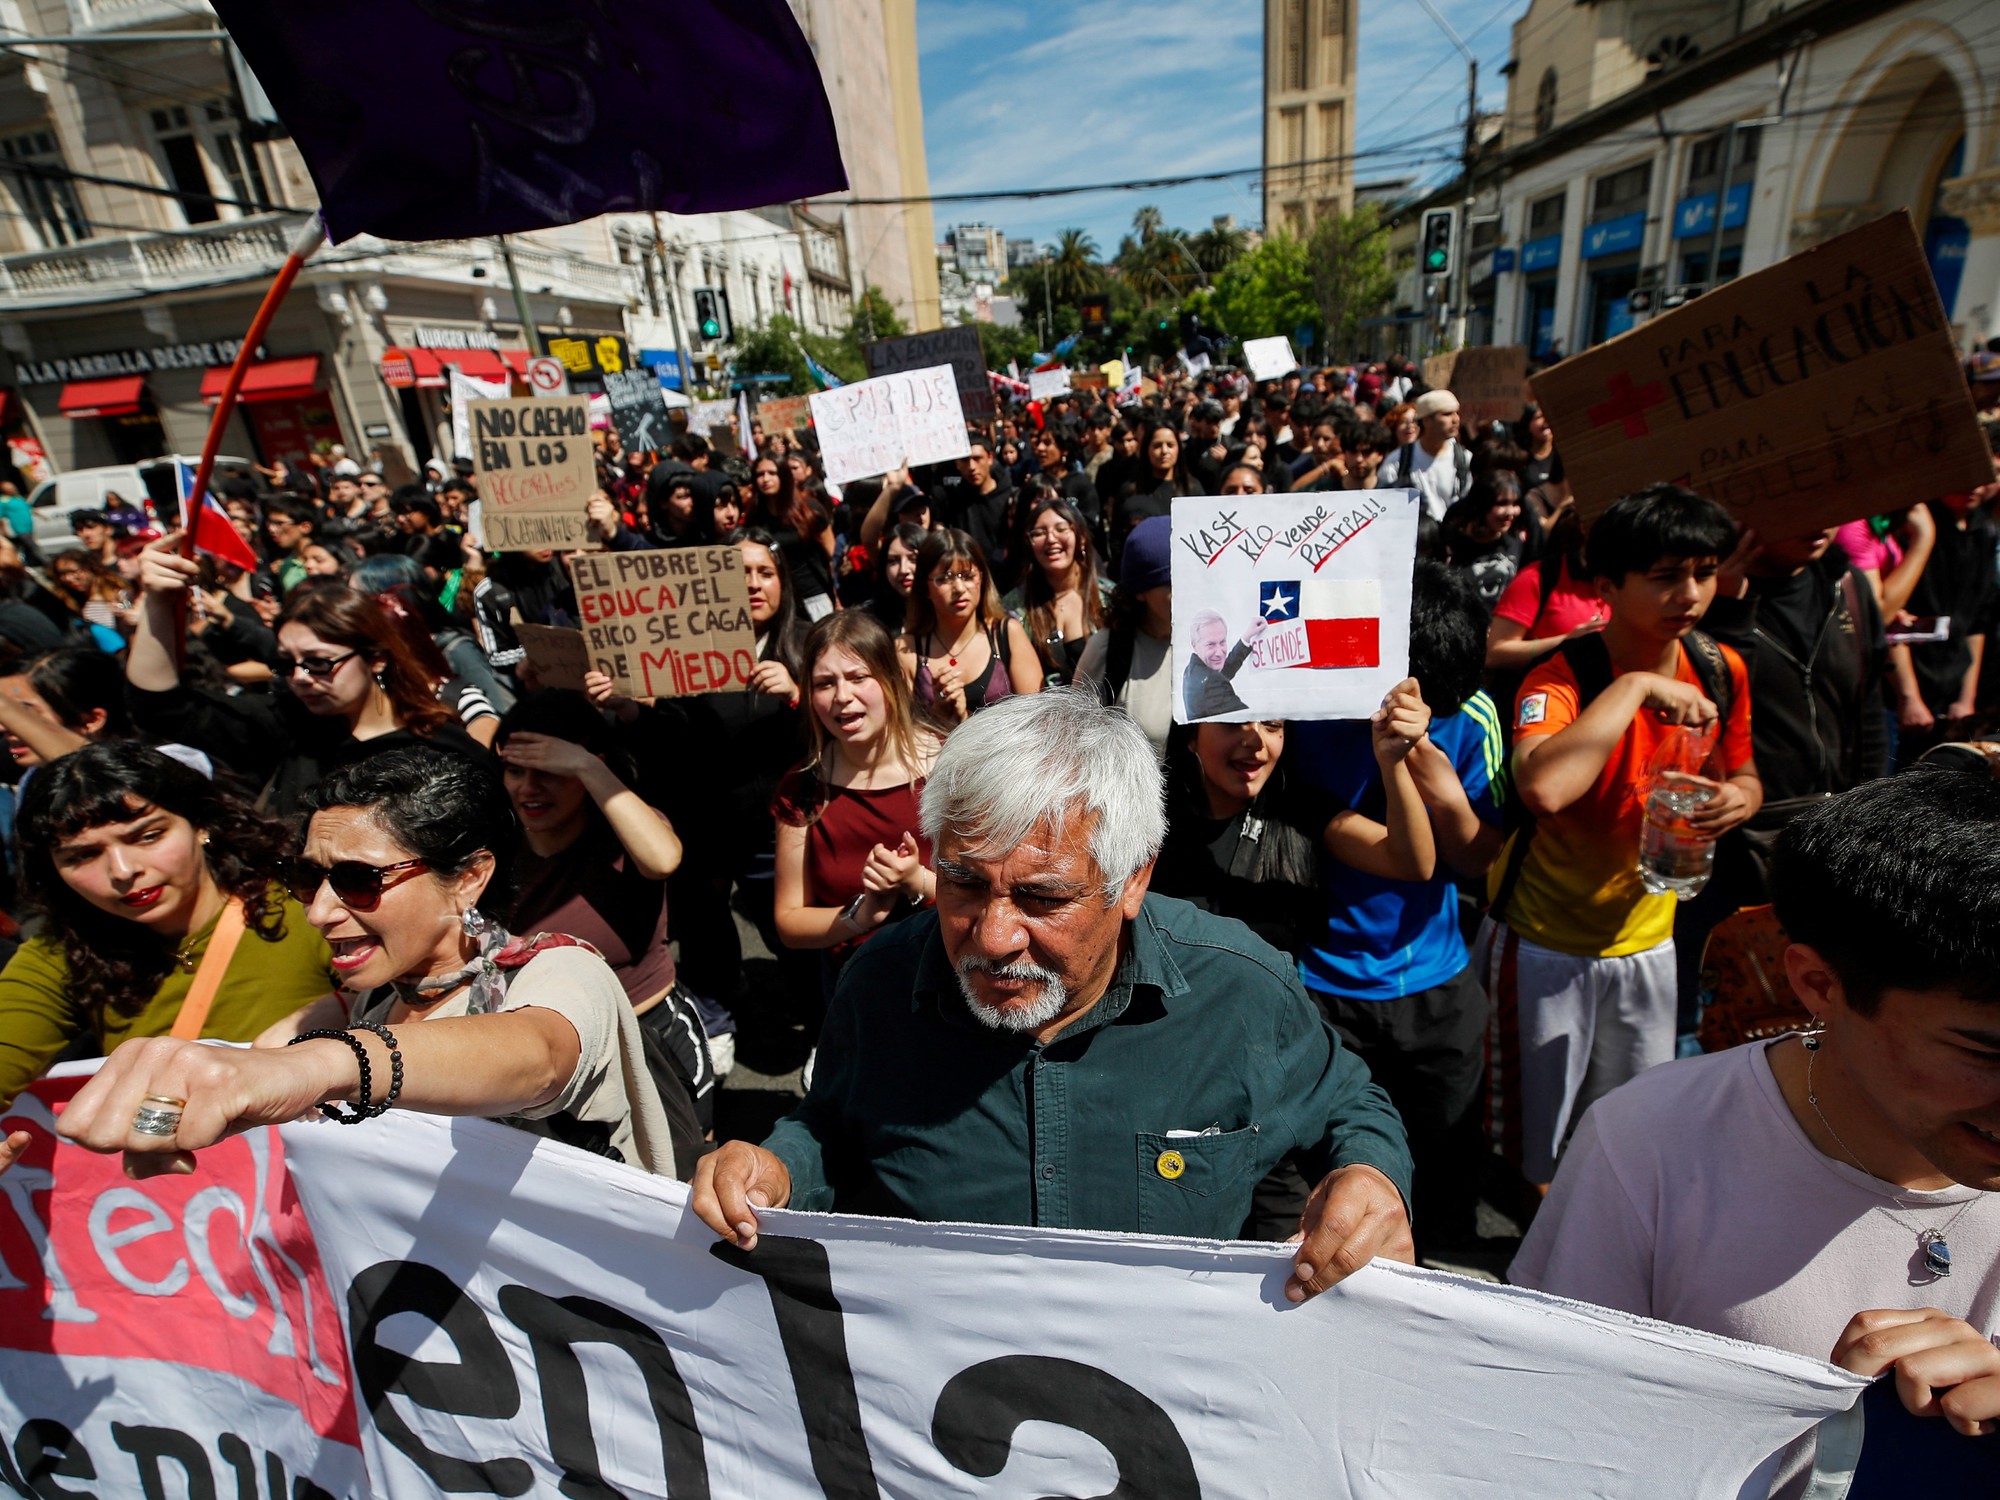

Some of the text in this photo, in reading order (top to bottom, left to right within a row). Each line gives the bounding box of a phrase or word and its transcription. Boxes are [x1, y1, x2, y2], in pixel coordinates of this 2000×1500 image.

[1659, 264, 1872, 367] PARA LA
[15, 363, 33, 384] A
[28, 360, 60, 384] LA
[54, 350, 152, 380] PARRILLA
[151, 342, 218, 369] DESDE
[474, 407, 515, 437] NO
[519, 406, 585, 437] CAEMO
[480, 438, 511, 471] EN
[573, 549, 736, 591] EL POBRE SE
[580, 584, 676, 624] EDUCA
[691, 576, 730, 605] EL
[589, 606, 752, 650] RICO SE CAGA
[1250, 627, 1305, 668] SE VENDE
[596, 653, 630, 680] DE
[347, 1260, 712, 1500] en
